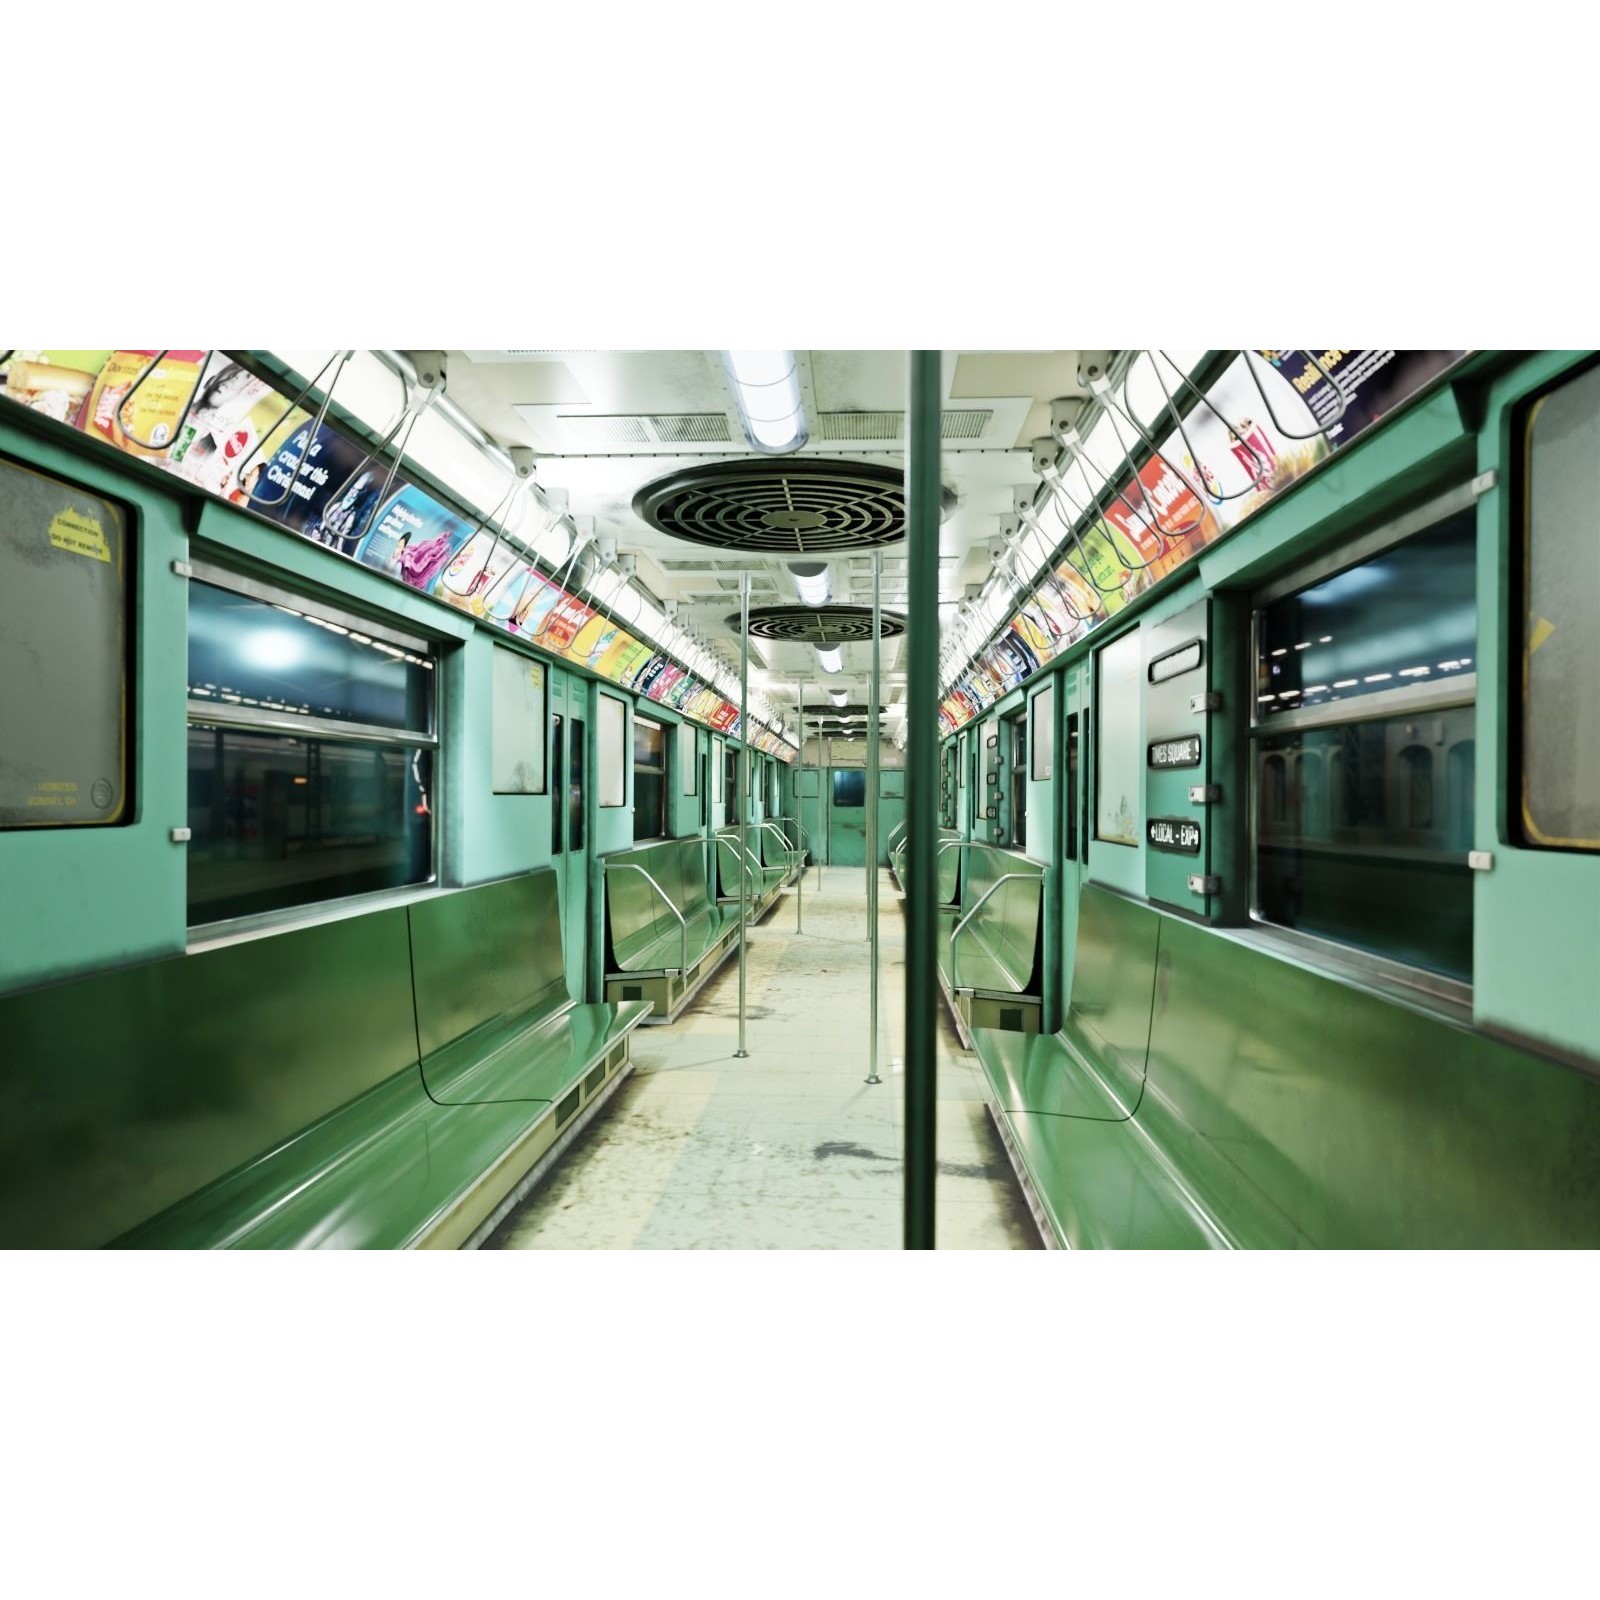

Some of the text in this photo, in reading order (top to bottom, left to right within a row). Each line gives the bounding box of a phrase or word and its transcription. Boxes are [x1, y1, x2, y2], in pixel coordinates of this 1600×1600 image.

[309, 444, 322, 457] a
[267, 465, 316, 500] Chrismas!
[310, 467, 328, 486] this
[1168, 740, 1191, 764] SQUARE
[1155, 823, 1174, 844] LOCAL
